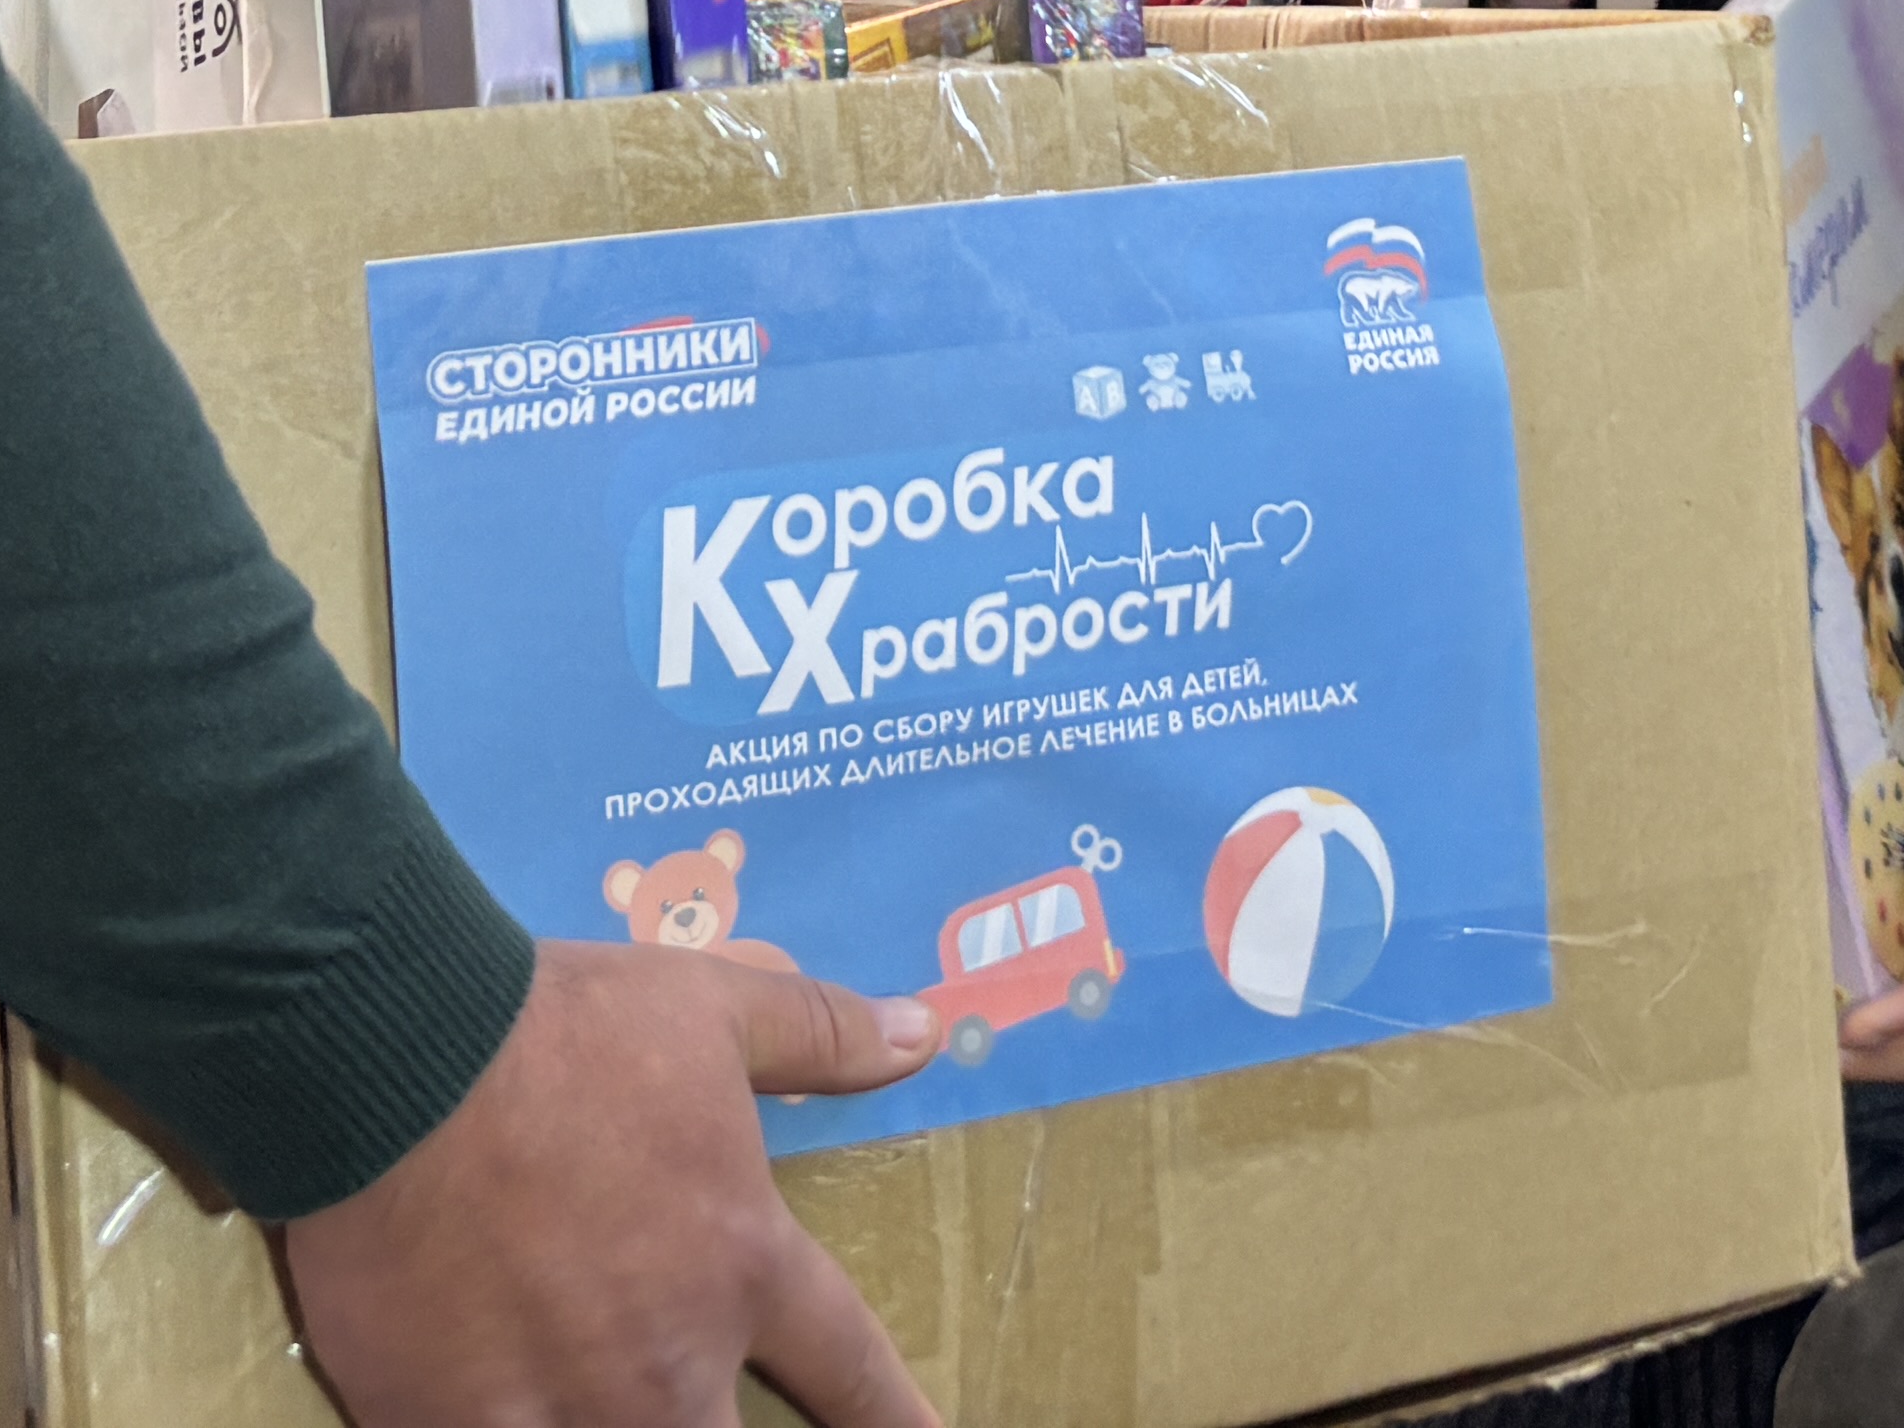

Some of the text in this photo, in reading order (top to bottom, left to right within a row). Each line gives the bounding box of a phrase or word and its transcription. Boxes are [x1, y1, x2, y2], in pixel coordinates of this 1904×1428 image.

[432, 324, 753, 397] СТОРОННИКИ
[1342, 323, 1435, 351] ЕДИНАЯ
[1347, 345, 1440, 375] РОССИЯ
[434, 375, 757, 444] ЕДИНОЙ РОССИИ
[656, 447, 1114, 688] Коробка
[756, 569, 1233, 716] Храбрости
[1636, 623, 1678, 645] 220V
[604, 680, 1359, 820] ПРОХОДЯЩИХ ДЛИТЕЛЬНОЕ ЛЕЧЕНИЕ В БОЛЬНИЦАХ
[705, 657, 1268, 770] АКЦИЯ ПО СБОРУ ИГРУШЕК ДЛЯ ДЕТЕЙ,
